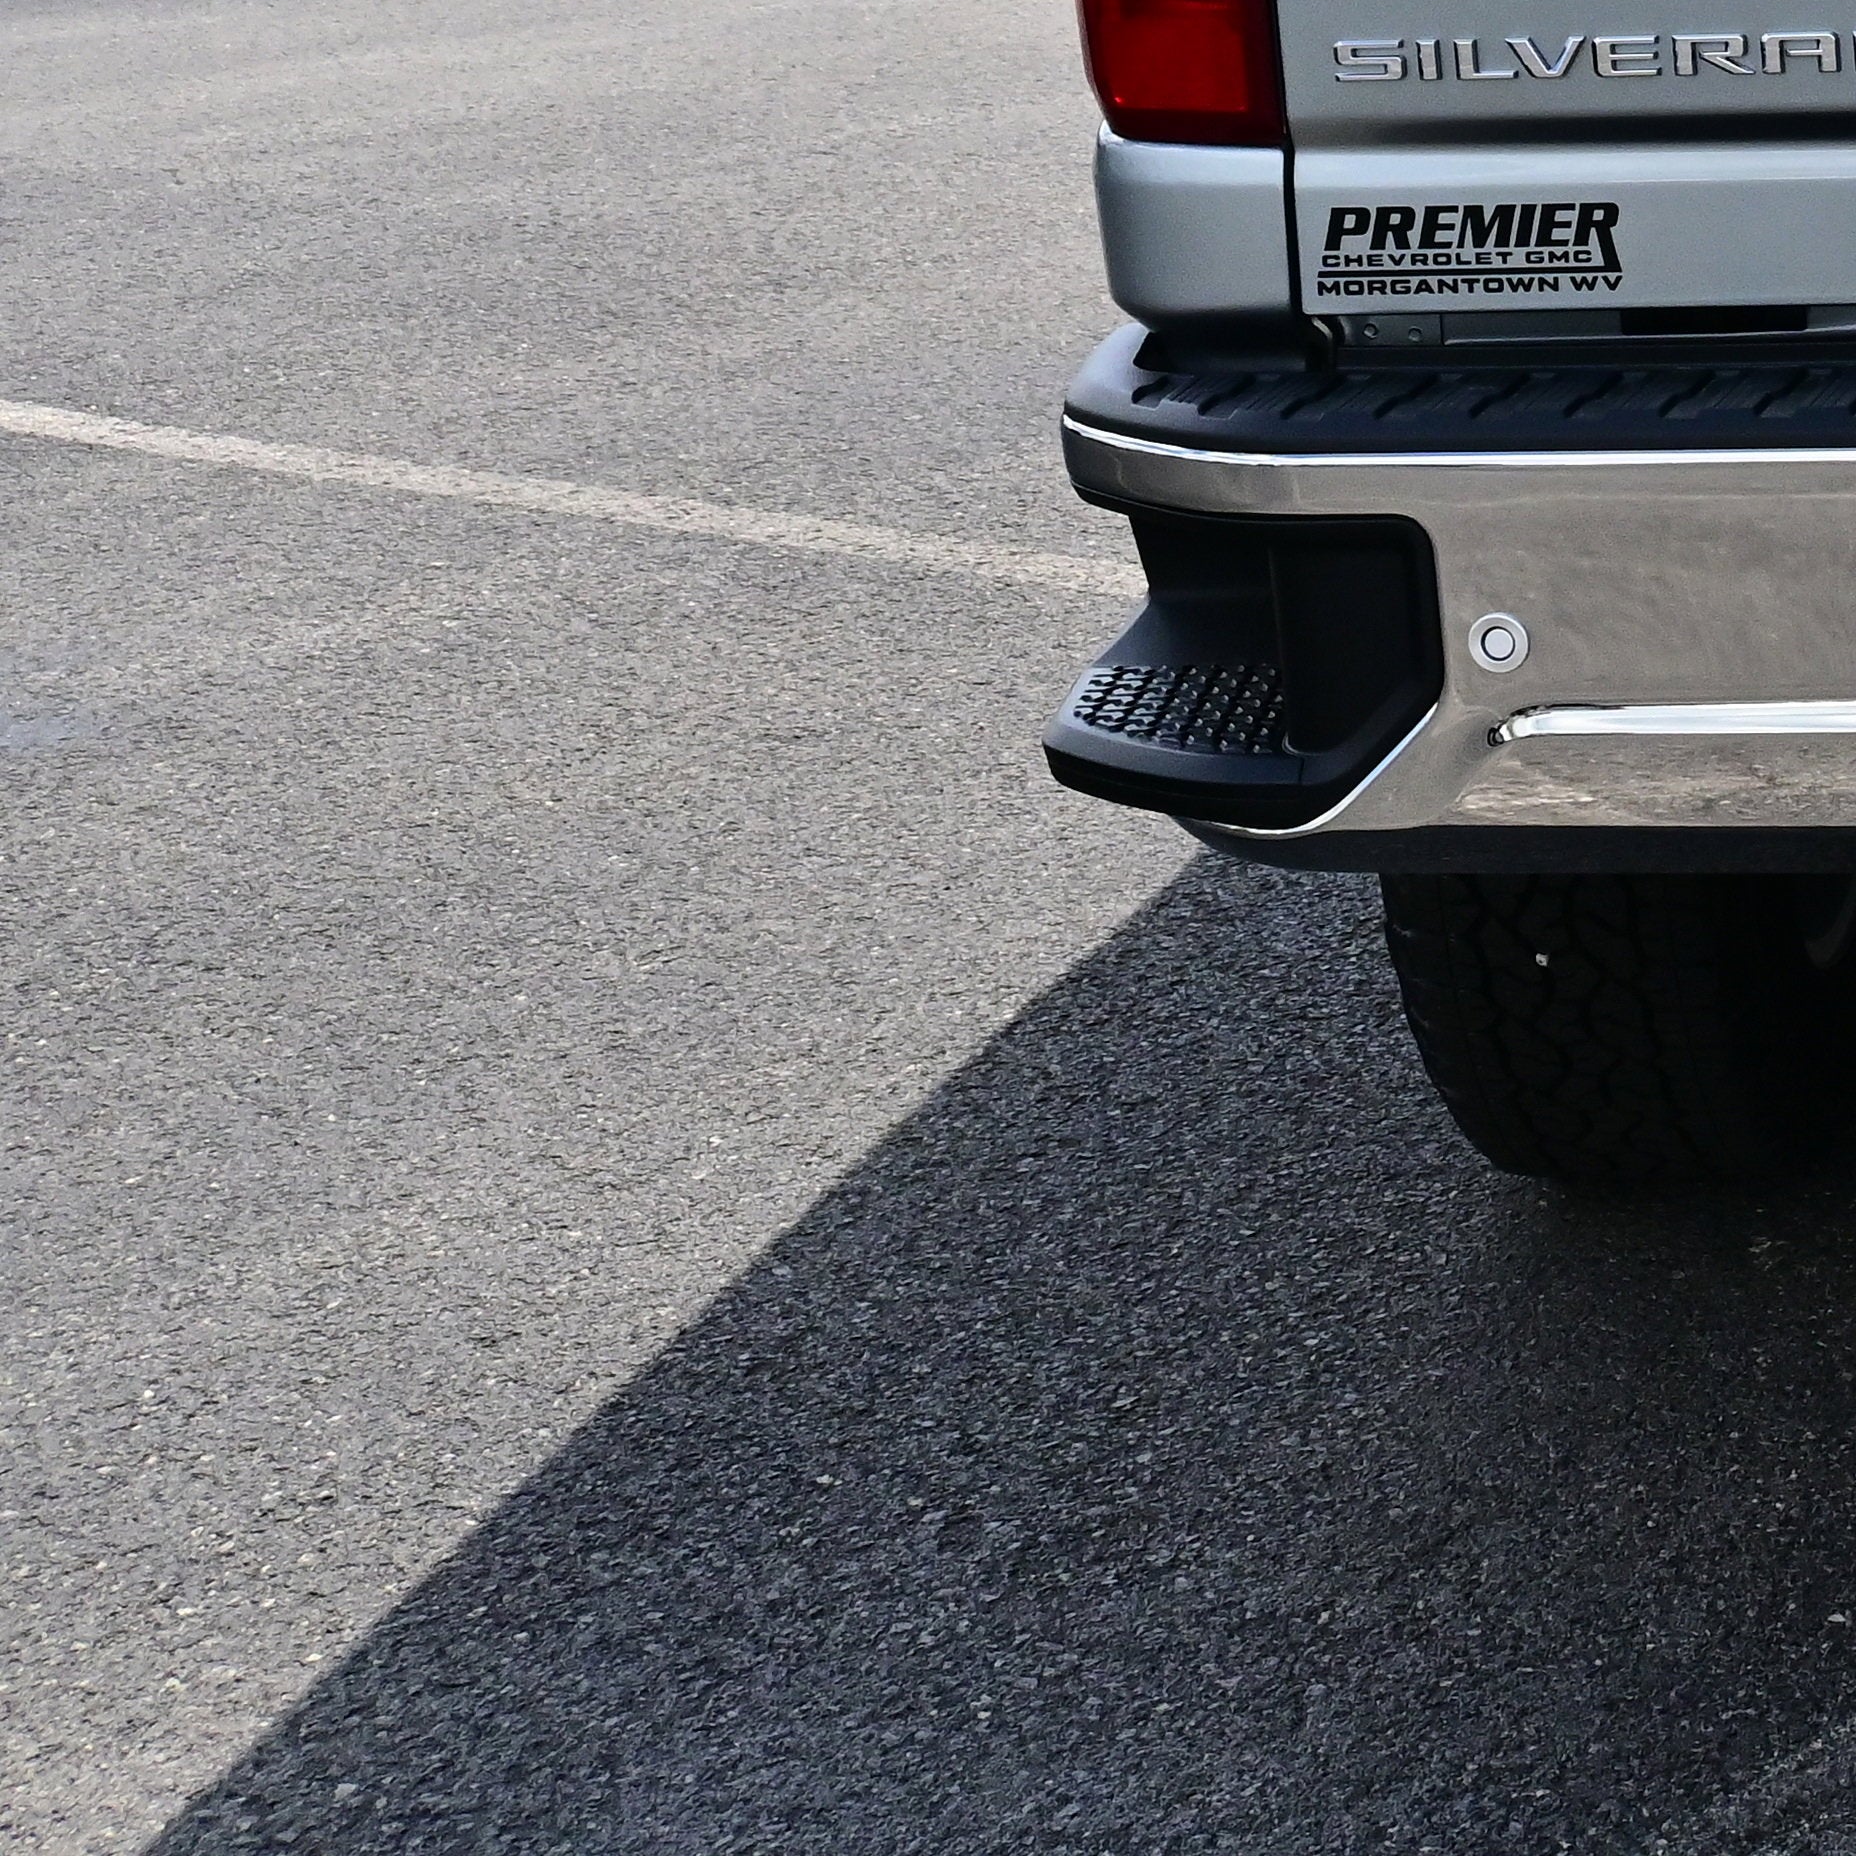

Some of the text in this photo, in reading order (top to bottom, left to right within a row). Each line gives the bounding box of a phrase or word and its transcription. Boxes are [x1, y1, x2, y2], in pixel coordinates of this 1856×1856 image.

[1323, 201, 1623, 272] PREMIER
[1321, 249, 1593, 268] CHEVROLET GMC
[1316, 274, 1623, 296] MORGANTOWN WV
